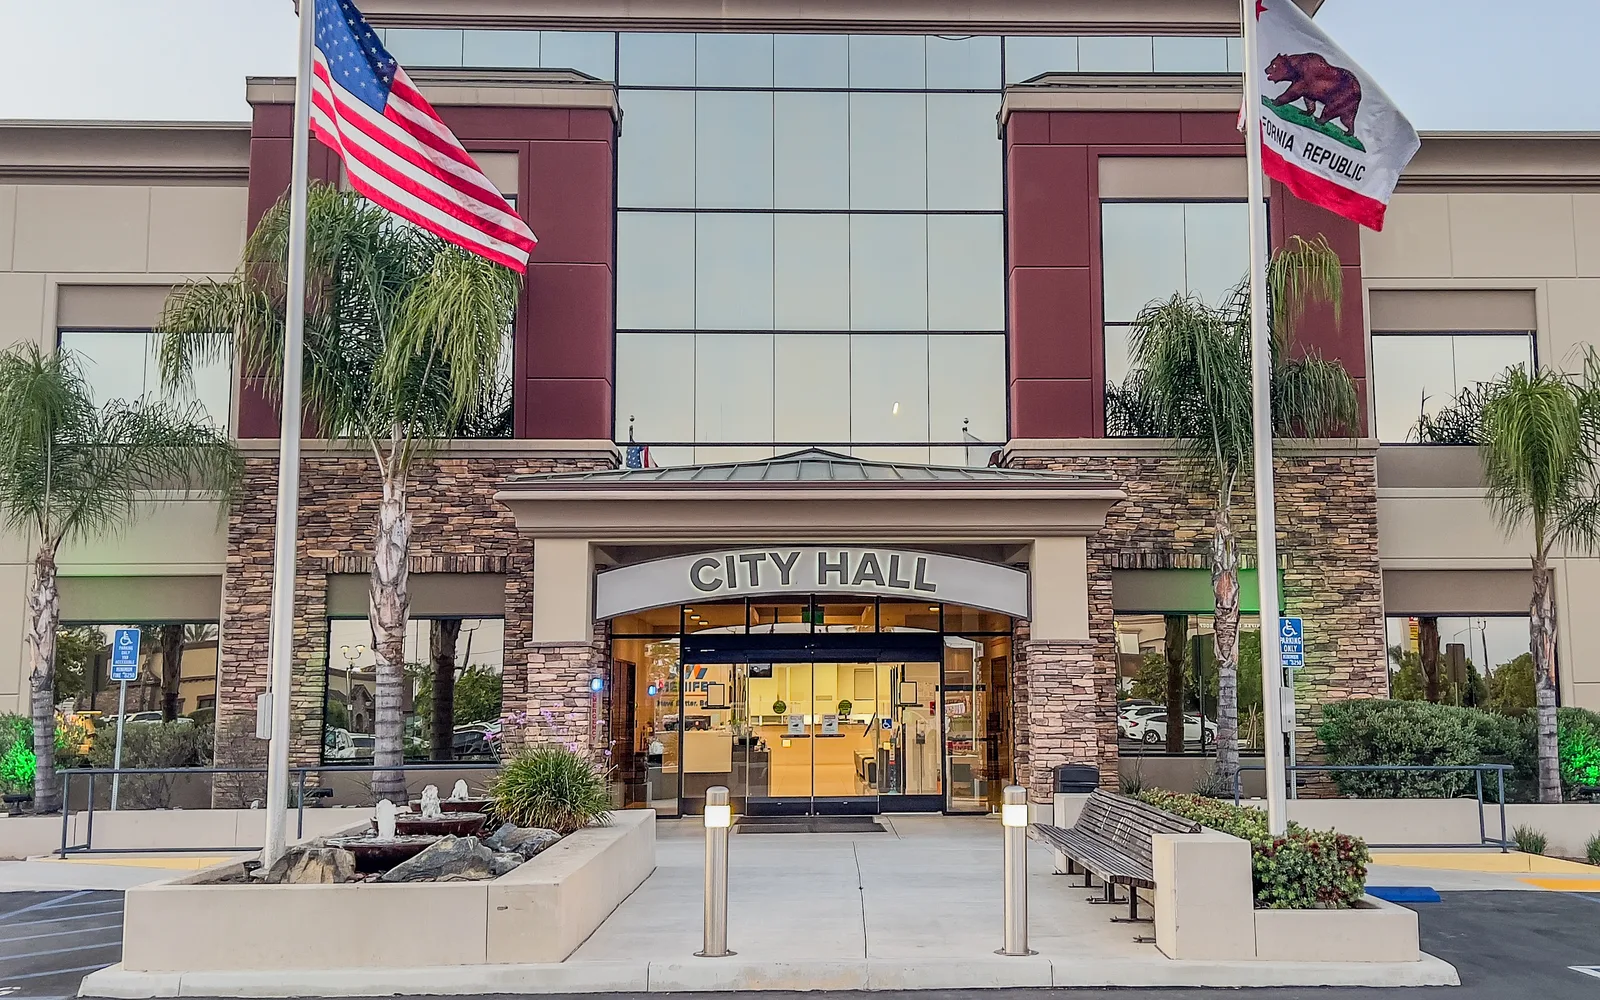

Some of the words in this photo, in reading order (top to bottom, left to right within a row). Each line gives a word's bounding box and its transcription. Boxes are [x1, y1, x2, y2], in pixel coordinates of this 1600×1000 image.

[1302, 142, 1366, 181] REPUBLIC
[690, 552, 801, 592] CITY
[817, 551, 937, 592] HALL
[1280, 637, 1302, 645] PARKING
